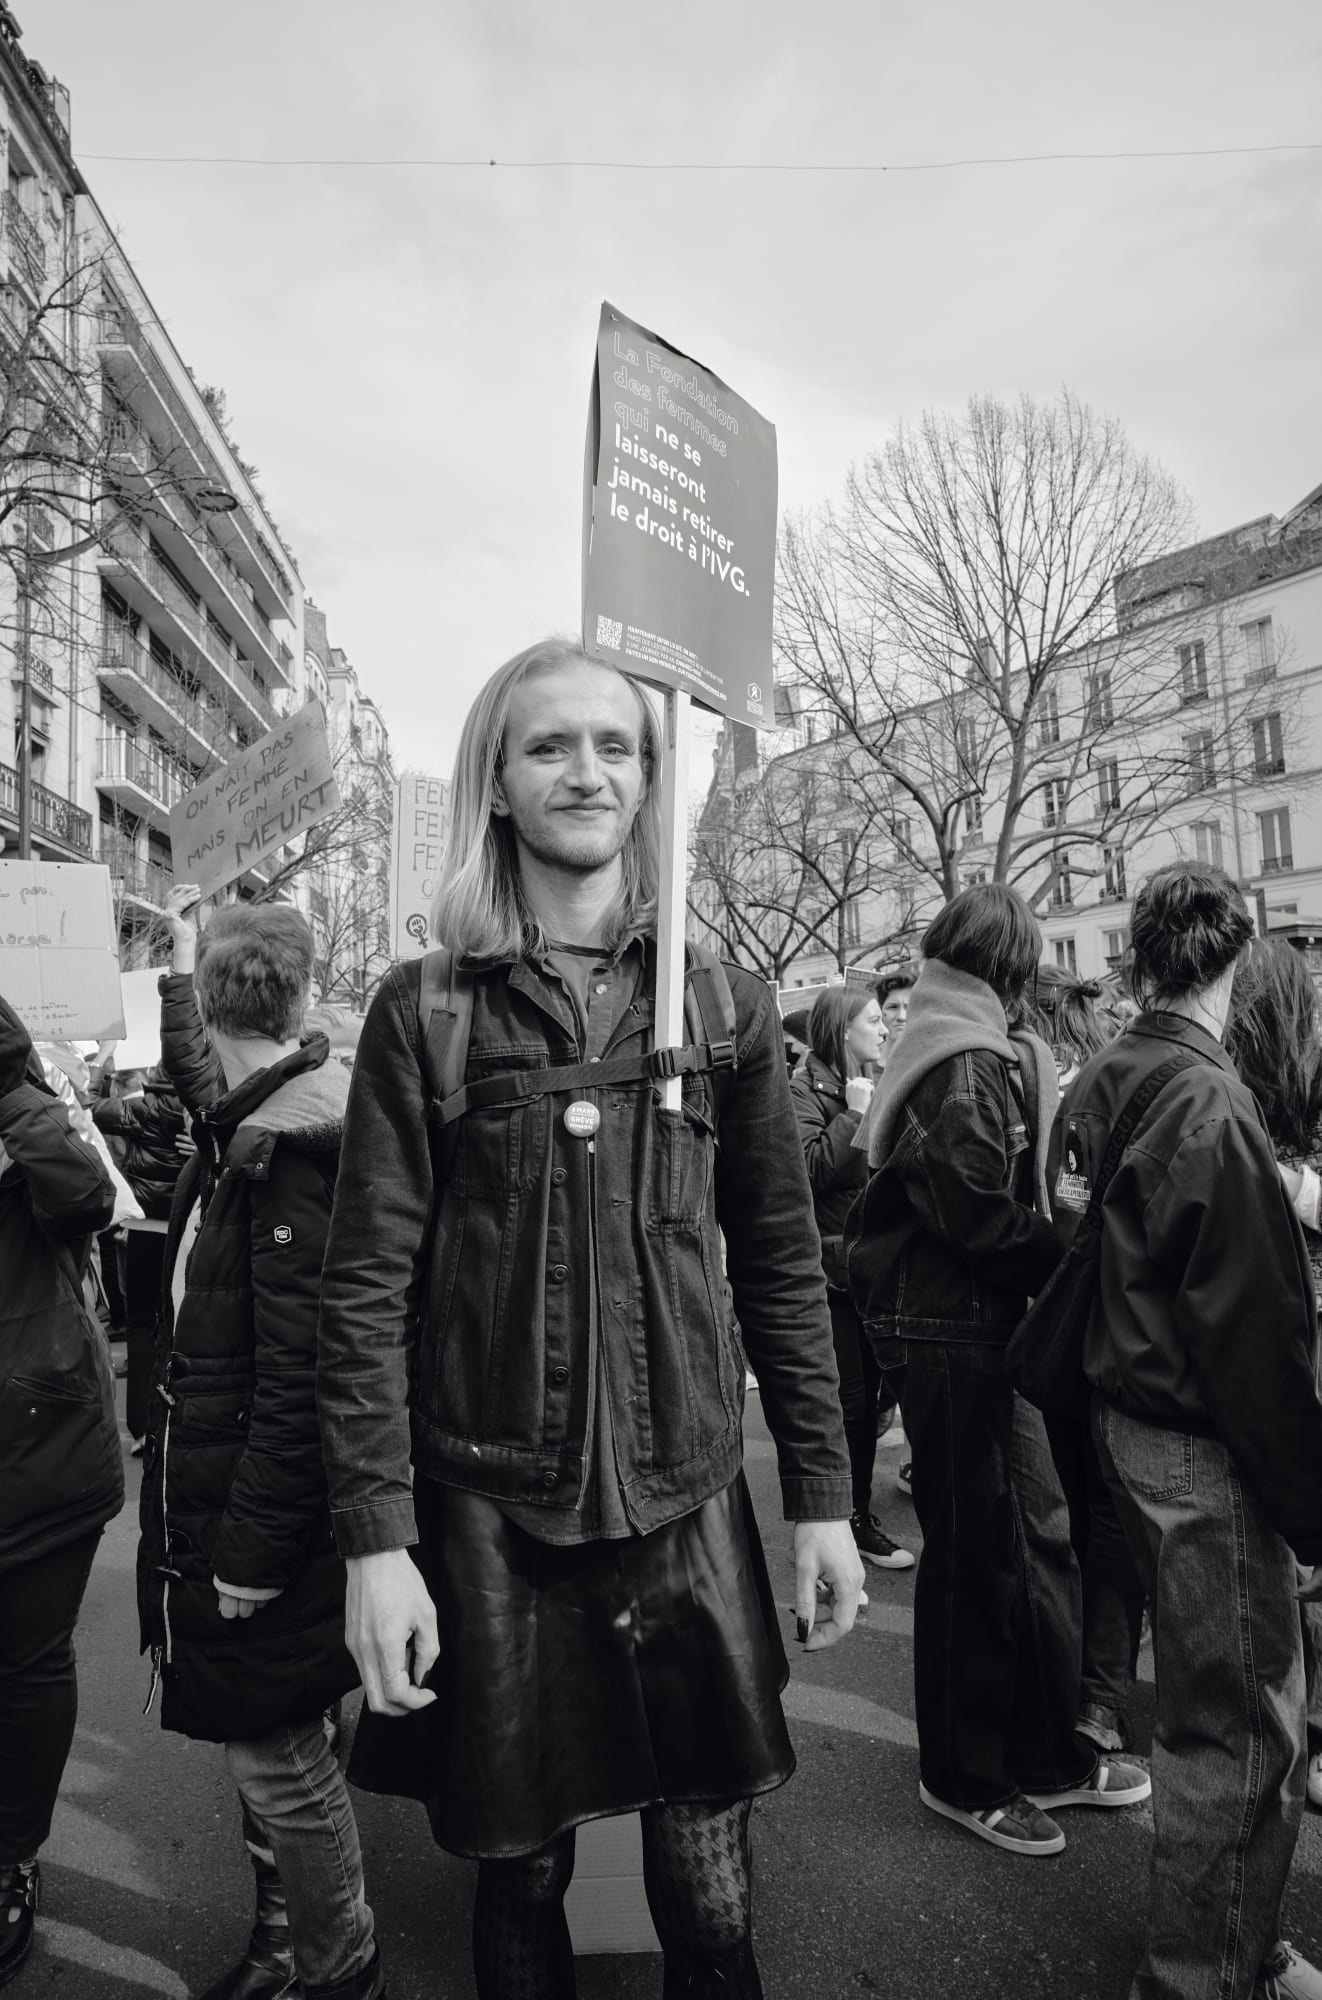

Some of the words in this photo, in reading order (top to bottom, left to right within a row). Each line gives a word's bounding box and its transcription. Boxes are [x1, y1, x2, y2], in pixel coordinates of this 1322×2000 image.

[613, 331, 639, 367] La
[645, 350, 739, 435] Fondation
[613, 365, 652, 401] des
[656, 385, 727, 457] femmes
[614, 401, 649, 433] qui
[655, 423, 679, 450] ne
[683, 442, 702, 467] se
[615, 423, 706, 503] laisseront
[607, 456, 678, 515] jamais
[682, 505, 735, 554] retirer
[610, 491, 630, 522] le
[635, 506, 684, 553] droit
[688, 535, 697, 562] à
[701, 543, 750, 597] l'IVG.
[185, 795, 209, 820] ON
[259, 731, 294, 766] PAS
[227, 758, 289, 814] FEMME
[243, 797, 268, 826] ON
[281, 768, 308, 800] EN
[235, 777, 334, 868] MEURT
